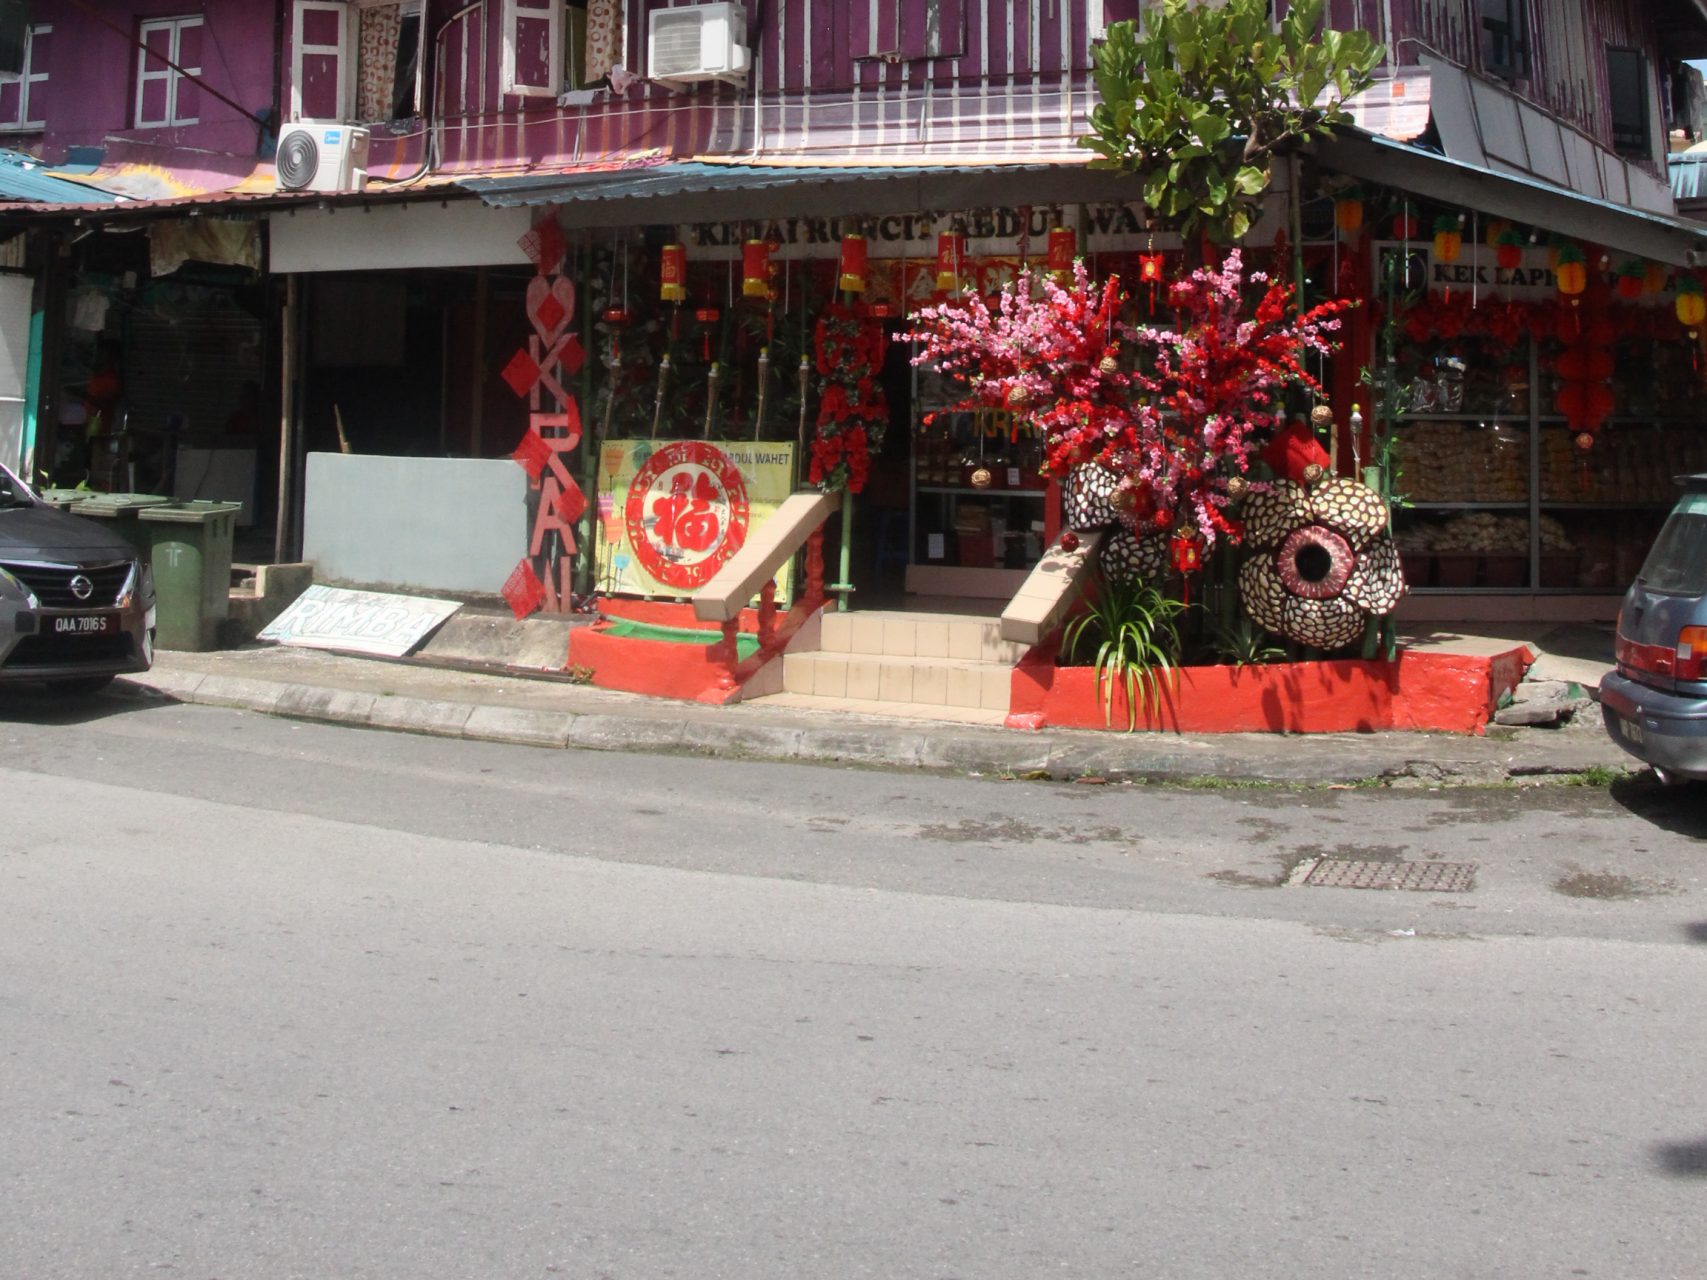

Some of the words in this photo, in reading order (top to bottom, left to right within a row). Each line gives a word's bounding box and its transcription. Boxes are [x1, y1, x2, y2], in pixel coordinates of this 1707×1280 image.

[695, 216, 798, 246] KEDAI
[804, 210, 945, 244] RUNCIT
[949, 205, 1066, 239] ABDUL
[1433, 263, 1488, 286] KEK
[1494, 266, 1556, 288] LAPI
[755, 453, 790, 465] WAHET
[55, 617, 77, 632] QAA
[77, 616, 99, 631] 7016
